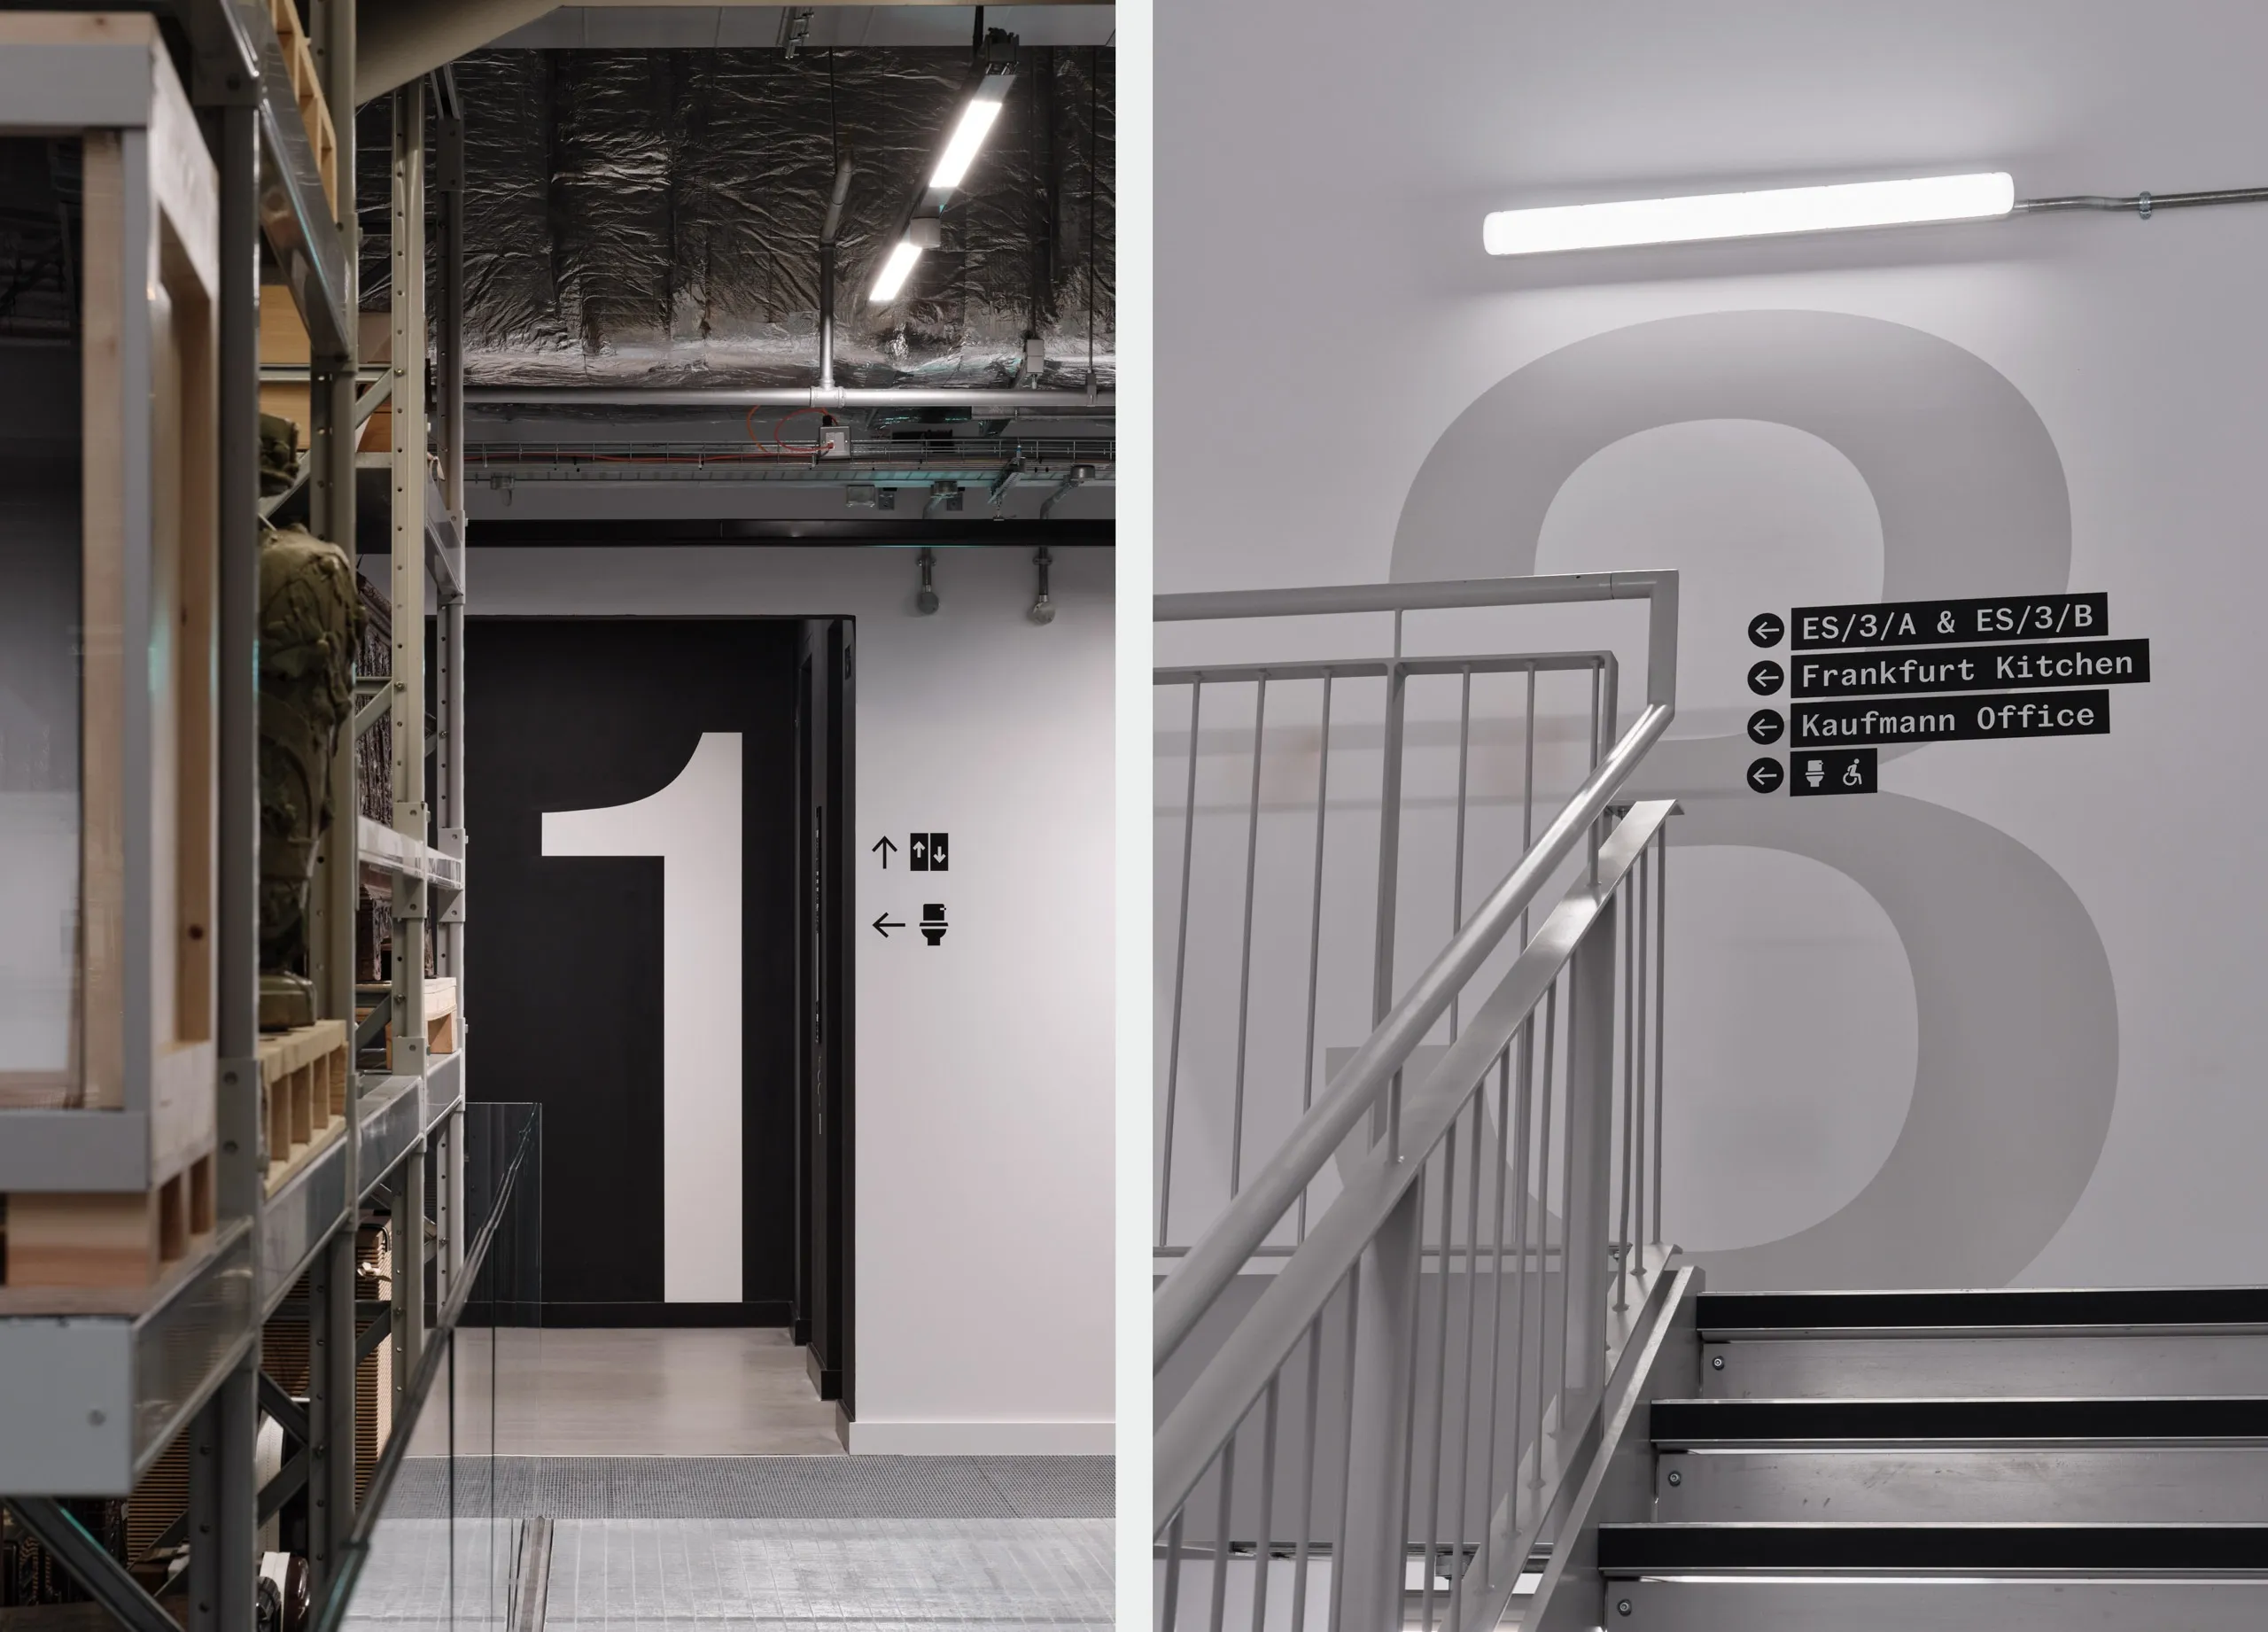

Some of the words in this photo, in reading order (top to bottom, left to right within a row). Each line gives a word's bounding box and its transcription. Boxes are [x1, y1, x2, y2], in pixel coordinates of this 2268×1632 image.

[1802, 611, 1916, 643] ES/3/A
[1937, 610, 1955, 634] &
[1977, 603, 2093, 635] ES/3/B
[1802, 658, 1975, 688] Frankfurt
[1997, 651, 2132, 680] Kitchen
[1802, 711, 1955, 737] Kaufmann
[1977, 703, 2094, 730] Office
[1325, 308, 2119, 1294] 3
[541, 732, 742, 1303] 1
